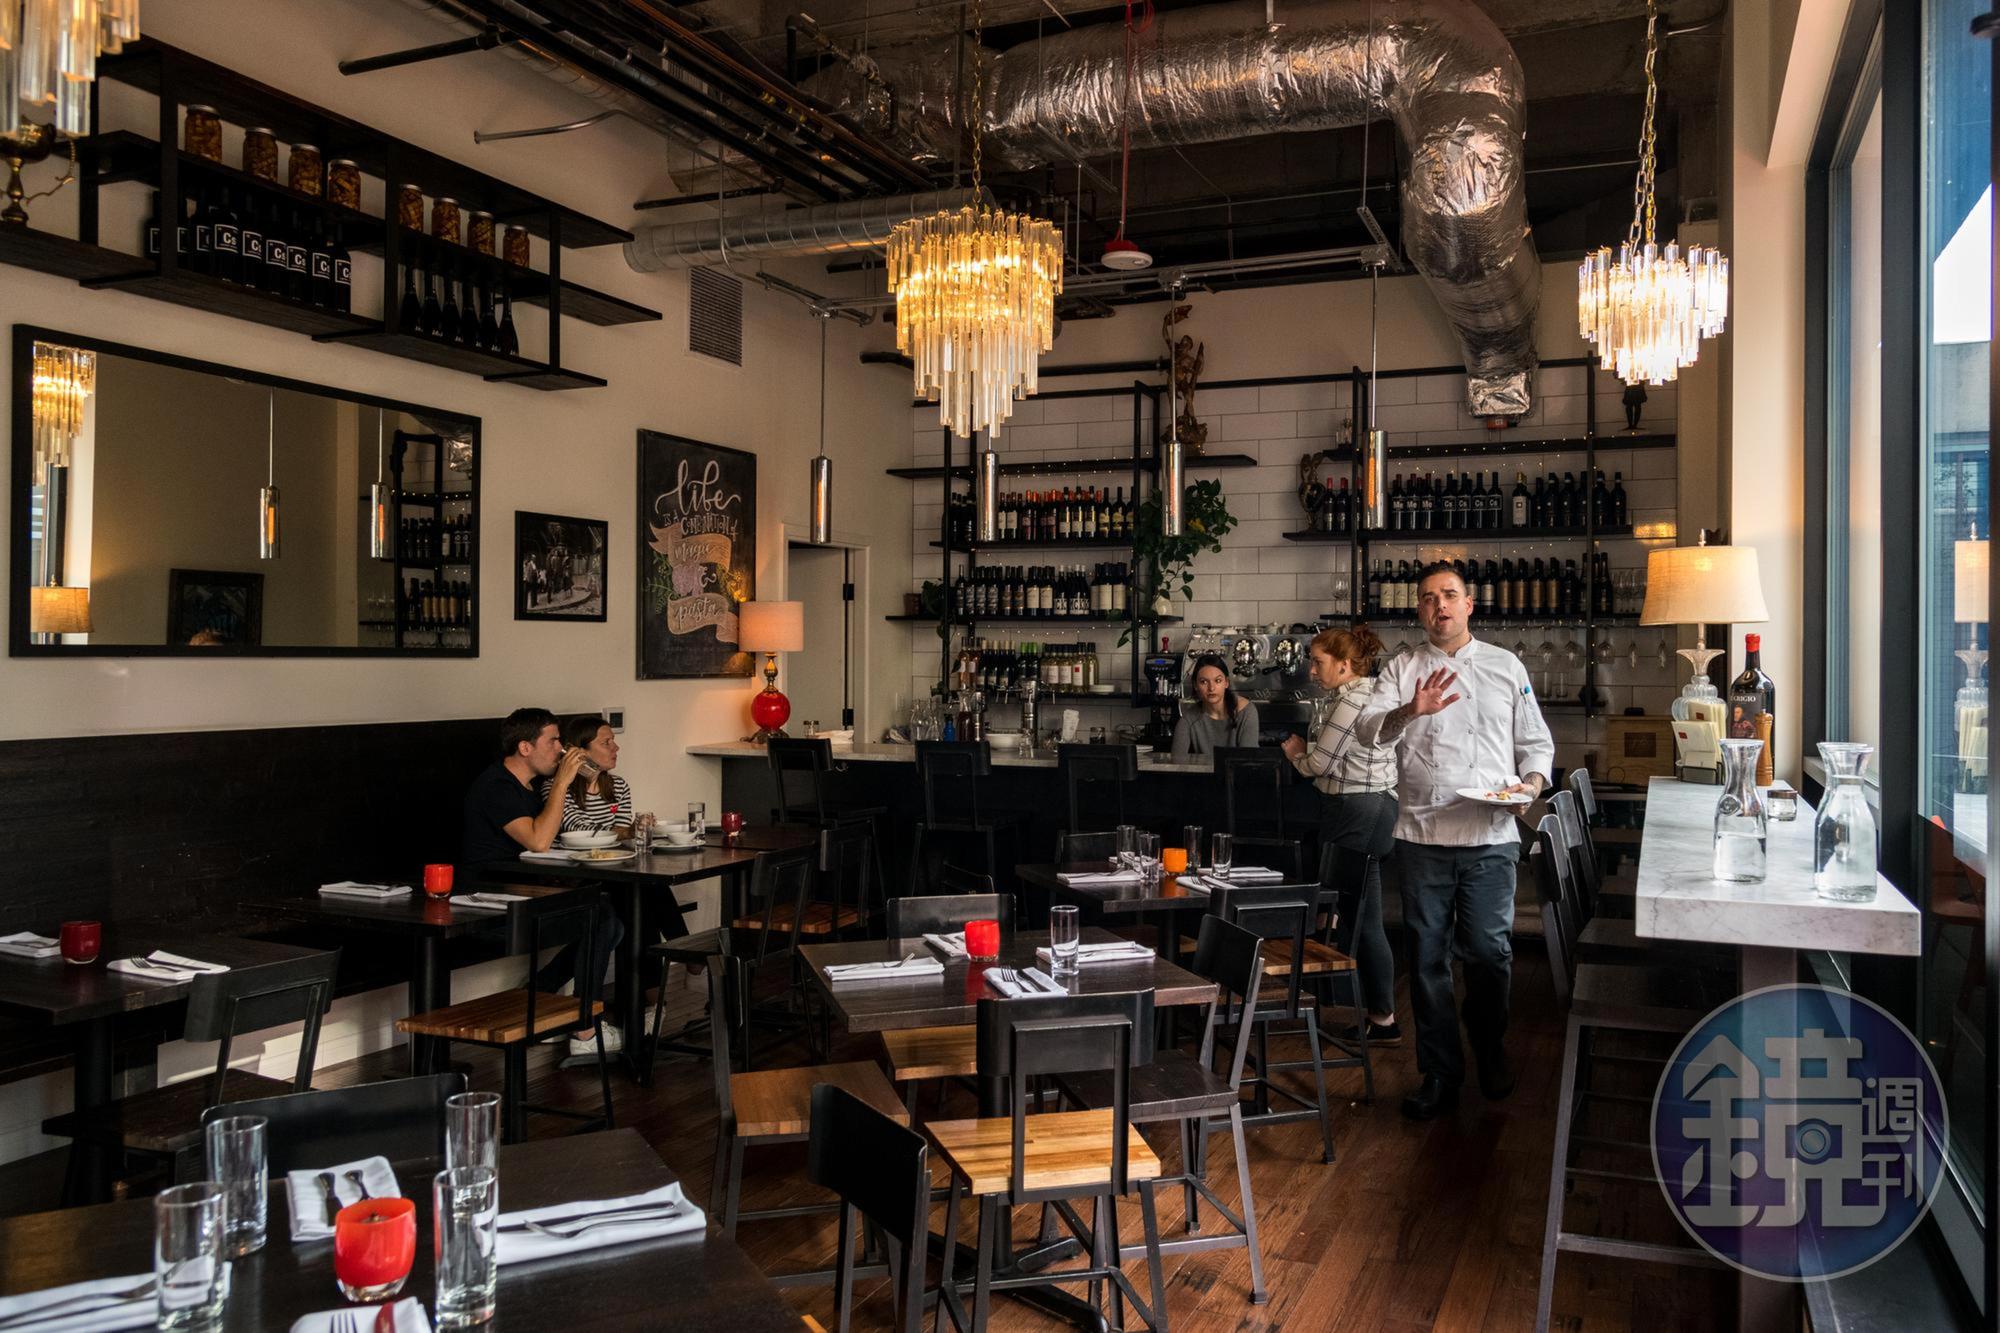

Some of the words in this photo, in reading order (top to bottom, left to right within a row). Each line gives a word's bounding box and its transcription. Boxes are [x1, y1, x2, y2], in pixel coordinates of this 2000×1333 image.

[223, 232, 237, 246] Cs
[274, 248, 286, 261] Cs
[294, 254, 306, 267] Cs
[655, 459, 741, 516] life
[674, 597, 721, 631] pasta
